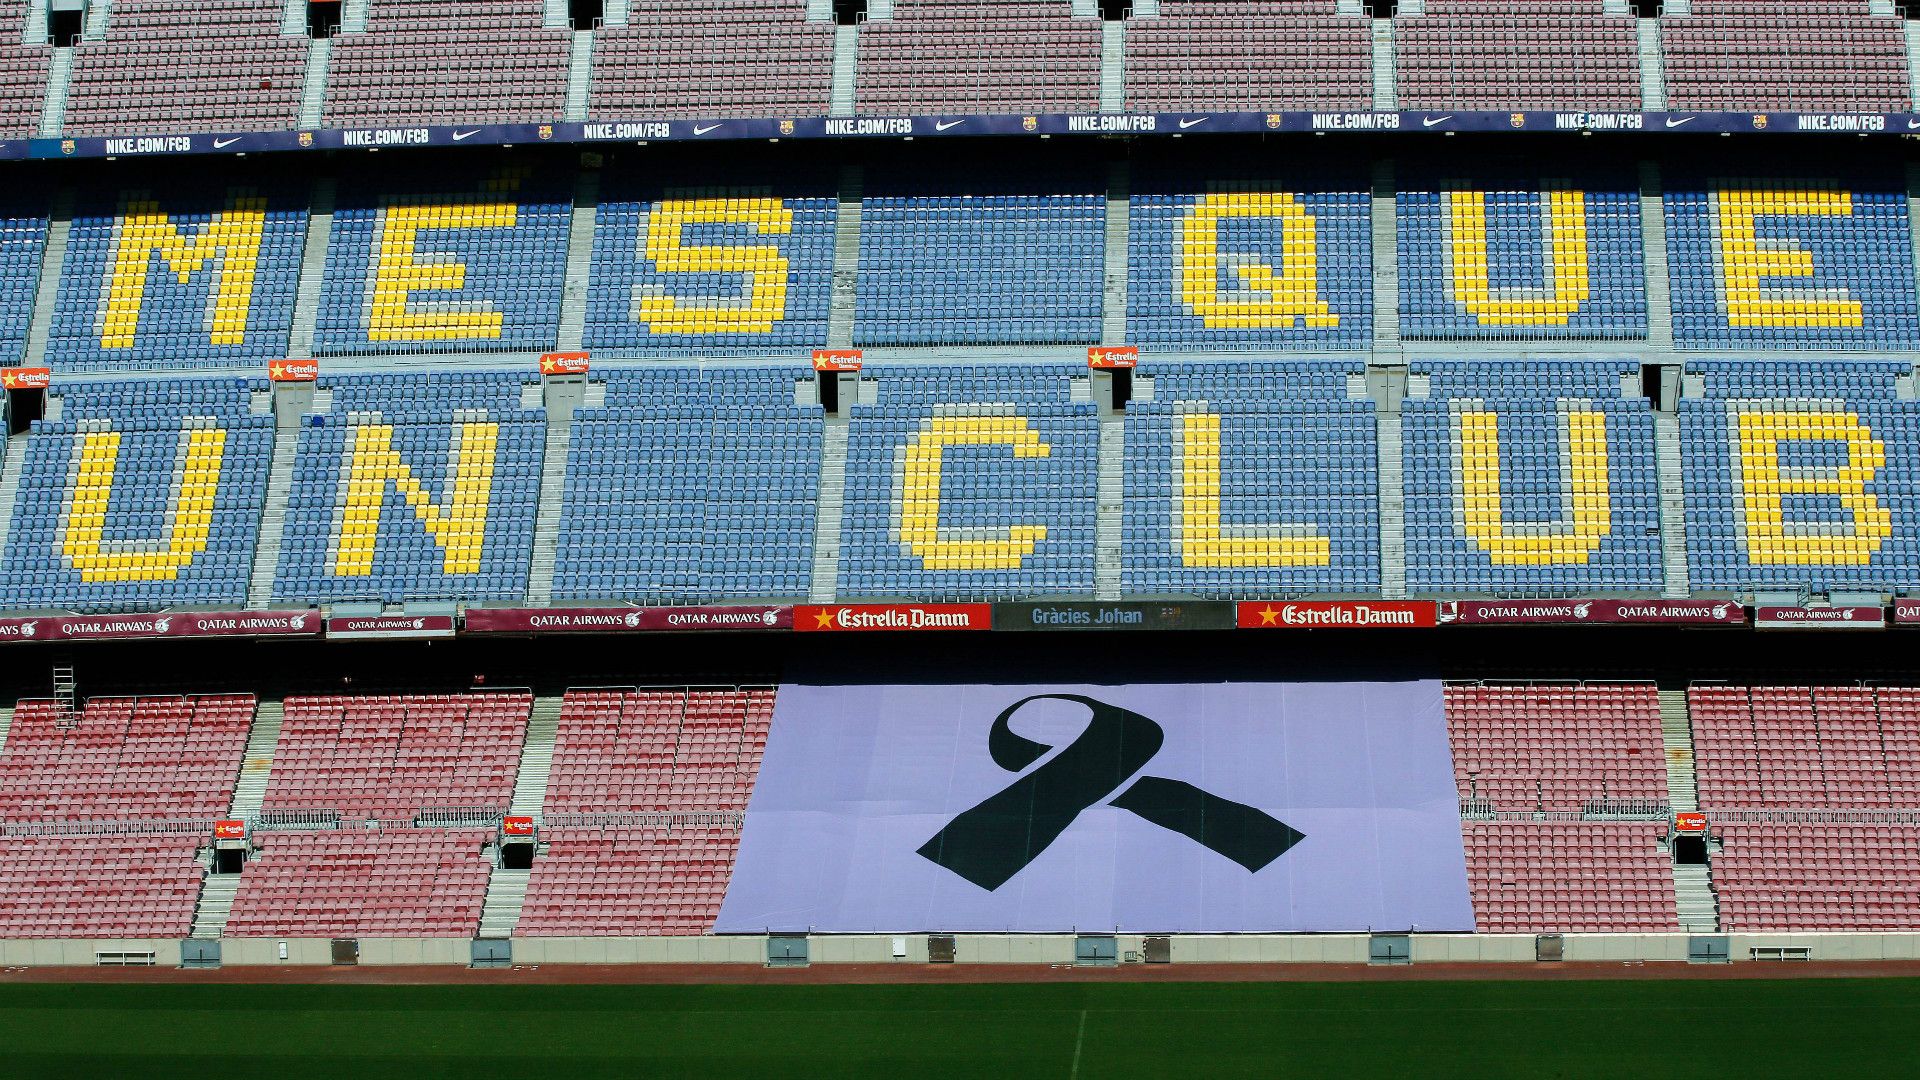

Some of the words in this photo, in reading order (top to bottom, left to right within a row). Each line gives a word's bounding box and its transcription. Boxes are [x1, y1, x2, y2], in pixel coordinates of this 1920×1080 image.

[825, 118, 912, 135] NIKE.COM/FCB
[1068, 114, 1156, 131] NIKE.COM/FCB
[1312, 113, 1400, 130] NIKE.COM/FCB
[1798, 114, 1885, 131] NIKE.COM/FCB
[583, 122, 670, 139] NIKE.COM/FCB
[343, 129, 429, 146] NIKE.COM/FCB
[106, 137, 190, 154] NIKE.COM/FCB
[1181, 190, 1863, 328] QUE
[557, 358, 588, 367] Estrella
[830, 355, 862, 364] Estrella
[1105, 352, 1137, 361] Estrella
[286, 364, 317, 374] Estrella
[18, 373, 49, 382] Estrella
[62, 423, 498, 583] UN
[899, 412, 1892, 569] CLUB
[837, 608, 908, 628] Estrella
[910, 609, 970, 629] Damm
[1032, 607, 1090, 624] Gràcies
[1094, 608, 1143, 624] Johan
[1282, 605, 1353, 625] Estrella
[1354, 606, 1415, 625] Damm
[1478, 608, 1518, 619] QATAR
[1521, 607, 1571, 616] AIRWAYS
[1617, 607, 1657, 618] QATAR
[1660, 607, 1710, 617] AIRWAYS
[1777, 611, 1804, 619] QATAR
[1806, 611, 1841, 619] AIRWAYS
[198, 620, 236, 631] QATAR
[240, 618, 288, 628] AIRWAYS
[348, 621, 376, 630] QATAR
[530, 616, 570, 627] QATAR
[573, 615, 623, 625] AIRWAYS
[668, 614, 708, 625] QATAR
[711, 614, 760, 623] AIRWAYS
[62, 623, 101, 635] QATAR
[104, 622, 153, 632] AIRWAYS
